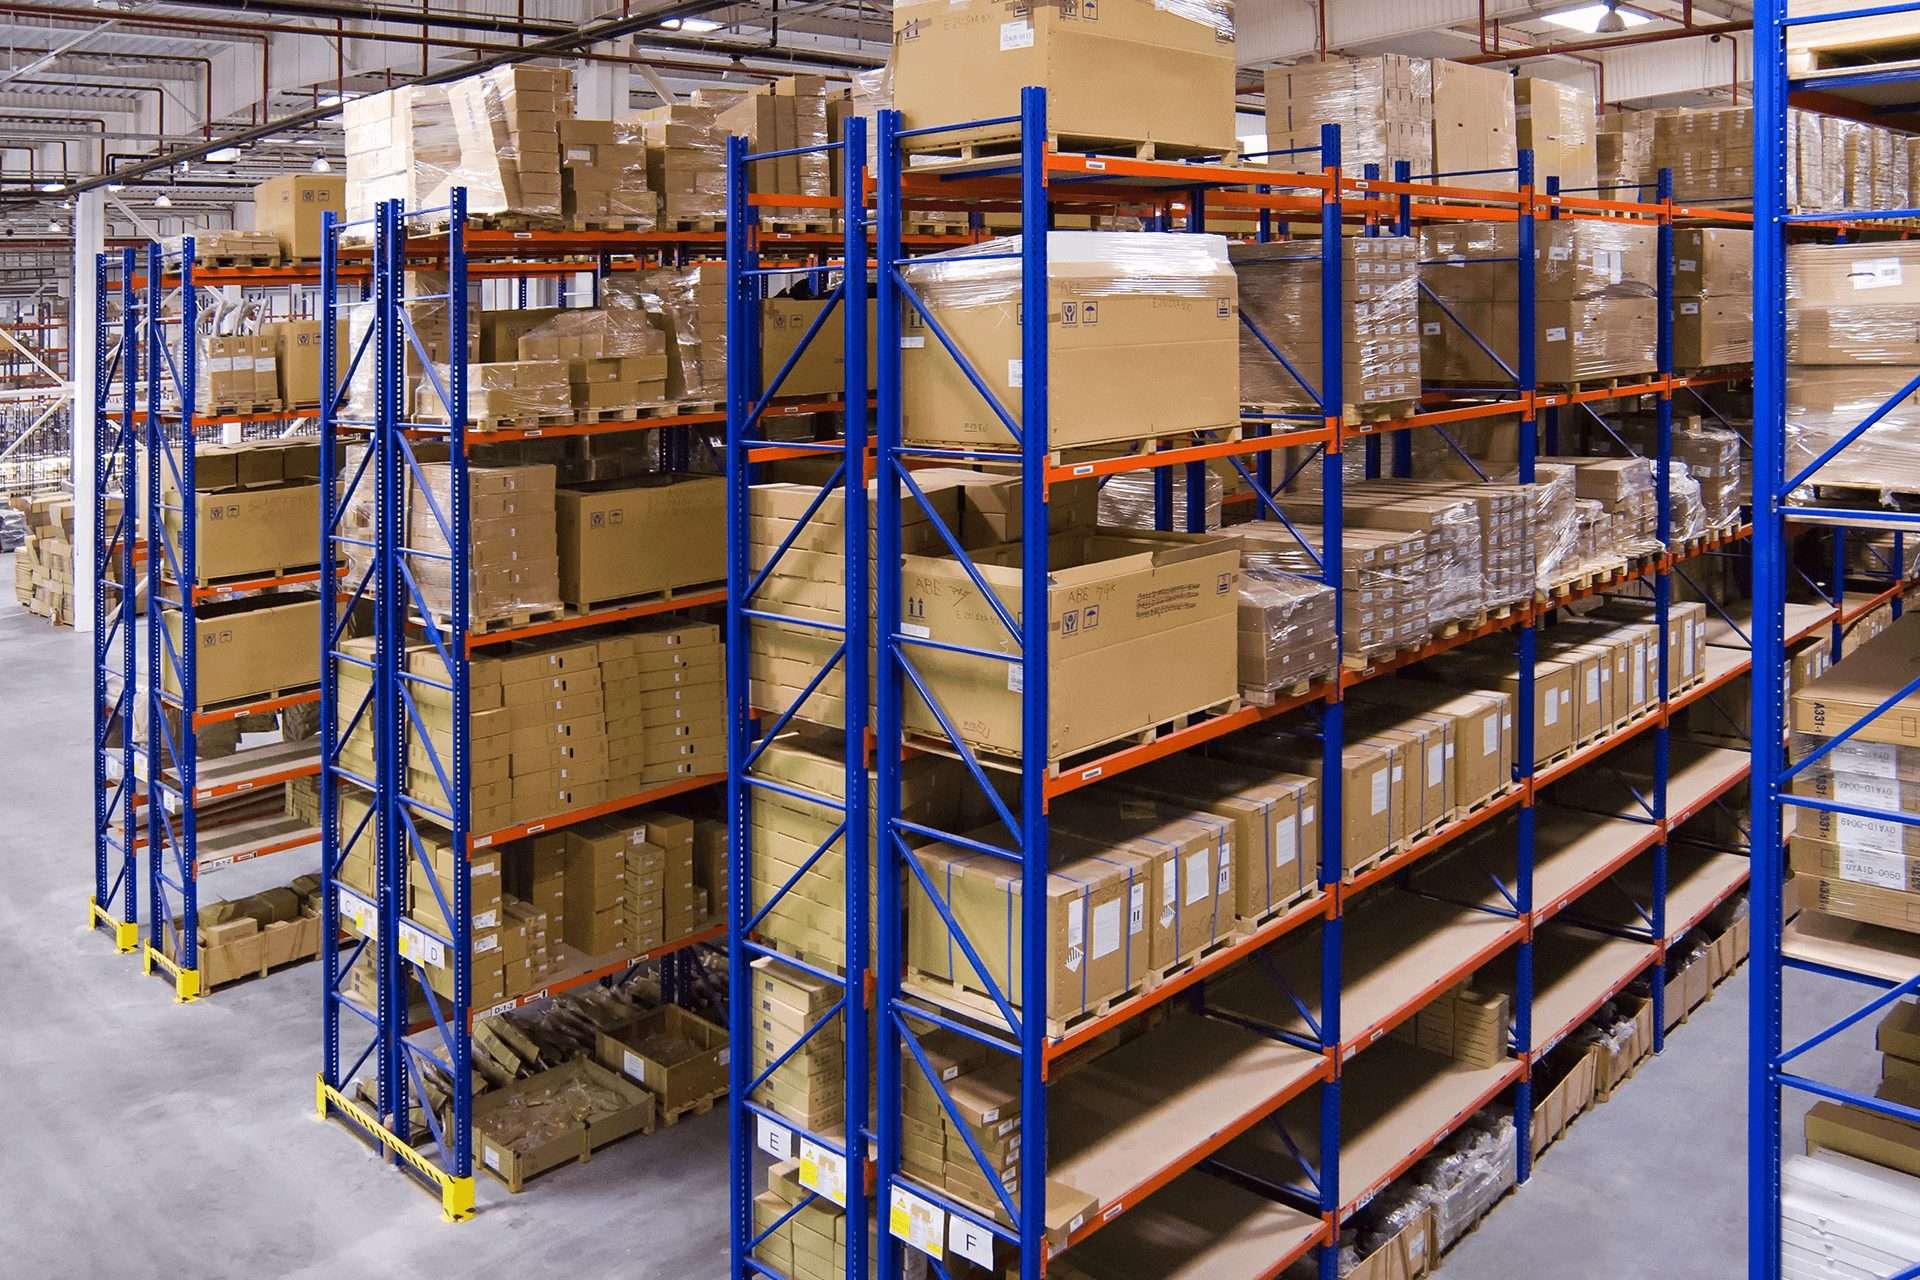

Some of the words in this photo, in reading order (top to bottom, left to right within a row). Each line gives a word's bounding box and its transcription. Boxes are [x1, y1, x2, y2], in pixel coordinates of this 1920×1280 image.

[1814, 702, 1825, 733] A331-1
[431, 947, 438, 961] D
[770, 1131, 779, 1152] E
[966, 1233, 977, 1251] F
